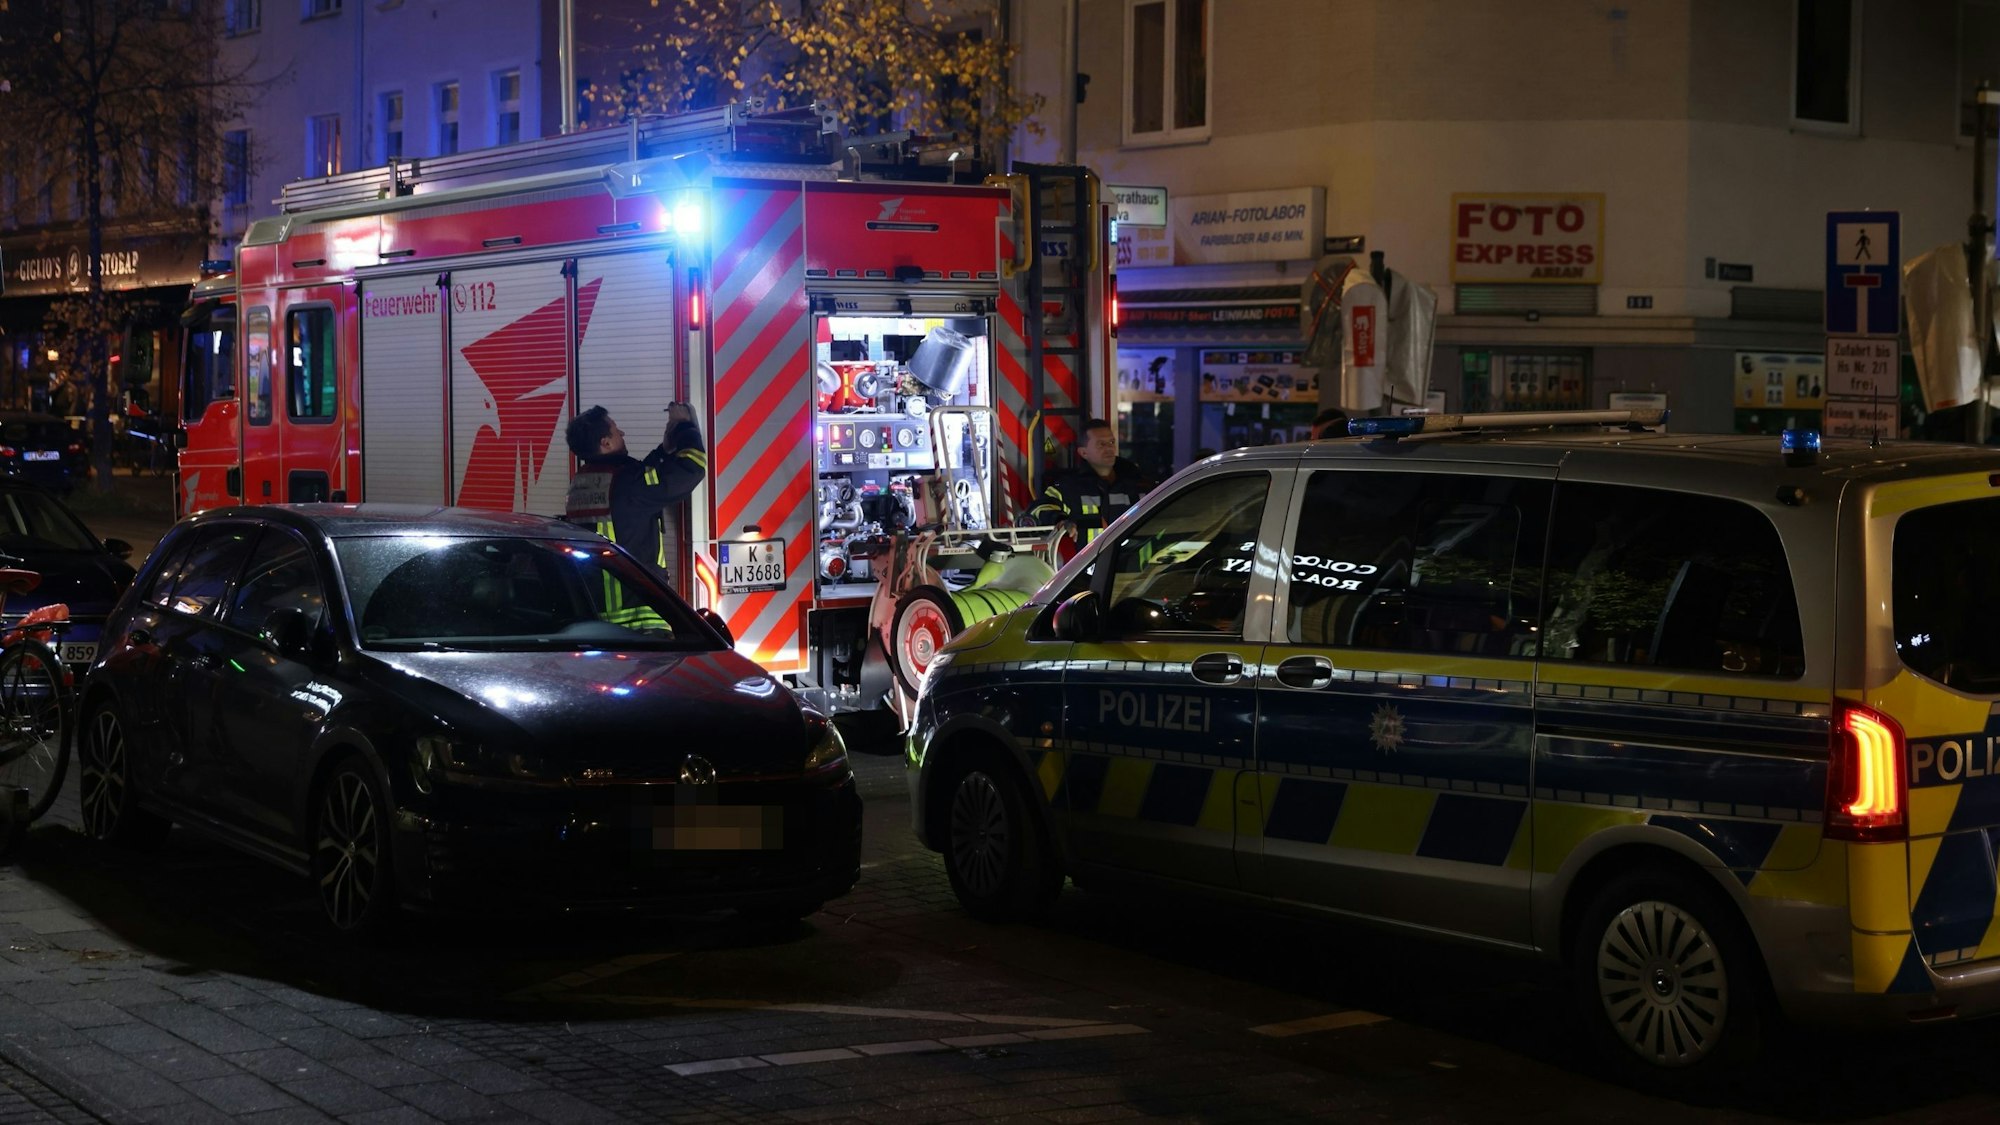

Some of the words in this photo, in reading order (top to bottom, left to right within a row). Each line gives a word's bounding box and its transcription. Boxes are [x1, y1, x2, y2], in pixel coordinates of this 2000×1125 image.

[1457, 203, 1585, 238] FOTO
[1257, 232, 1270, 243] AB
[1456, 243, 1594, 265] EXPRESS
[19, 257, 61, 281] GIGLIO'S
[1530, 266, 1585, 279] ARIAN
[365, 286, 438, 318] Feuerwehr
[470, 281, 495, 311] 112
[1876, 344, 1890, 358] bis
[1851, 376, 1874, 390] frei
[749, 545, 758, 562] K
[725, 566, 743, 583] LN
[746, 563, 781, 582] 3688
[66, 646, 94, 661] 859
[1098, 689, 1211, 733] POLIZEI
